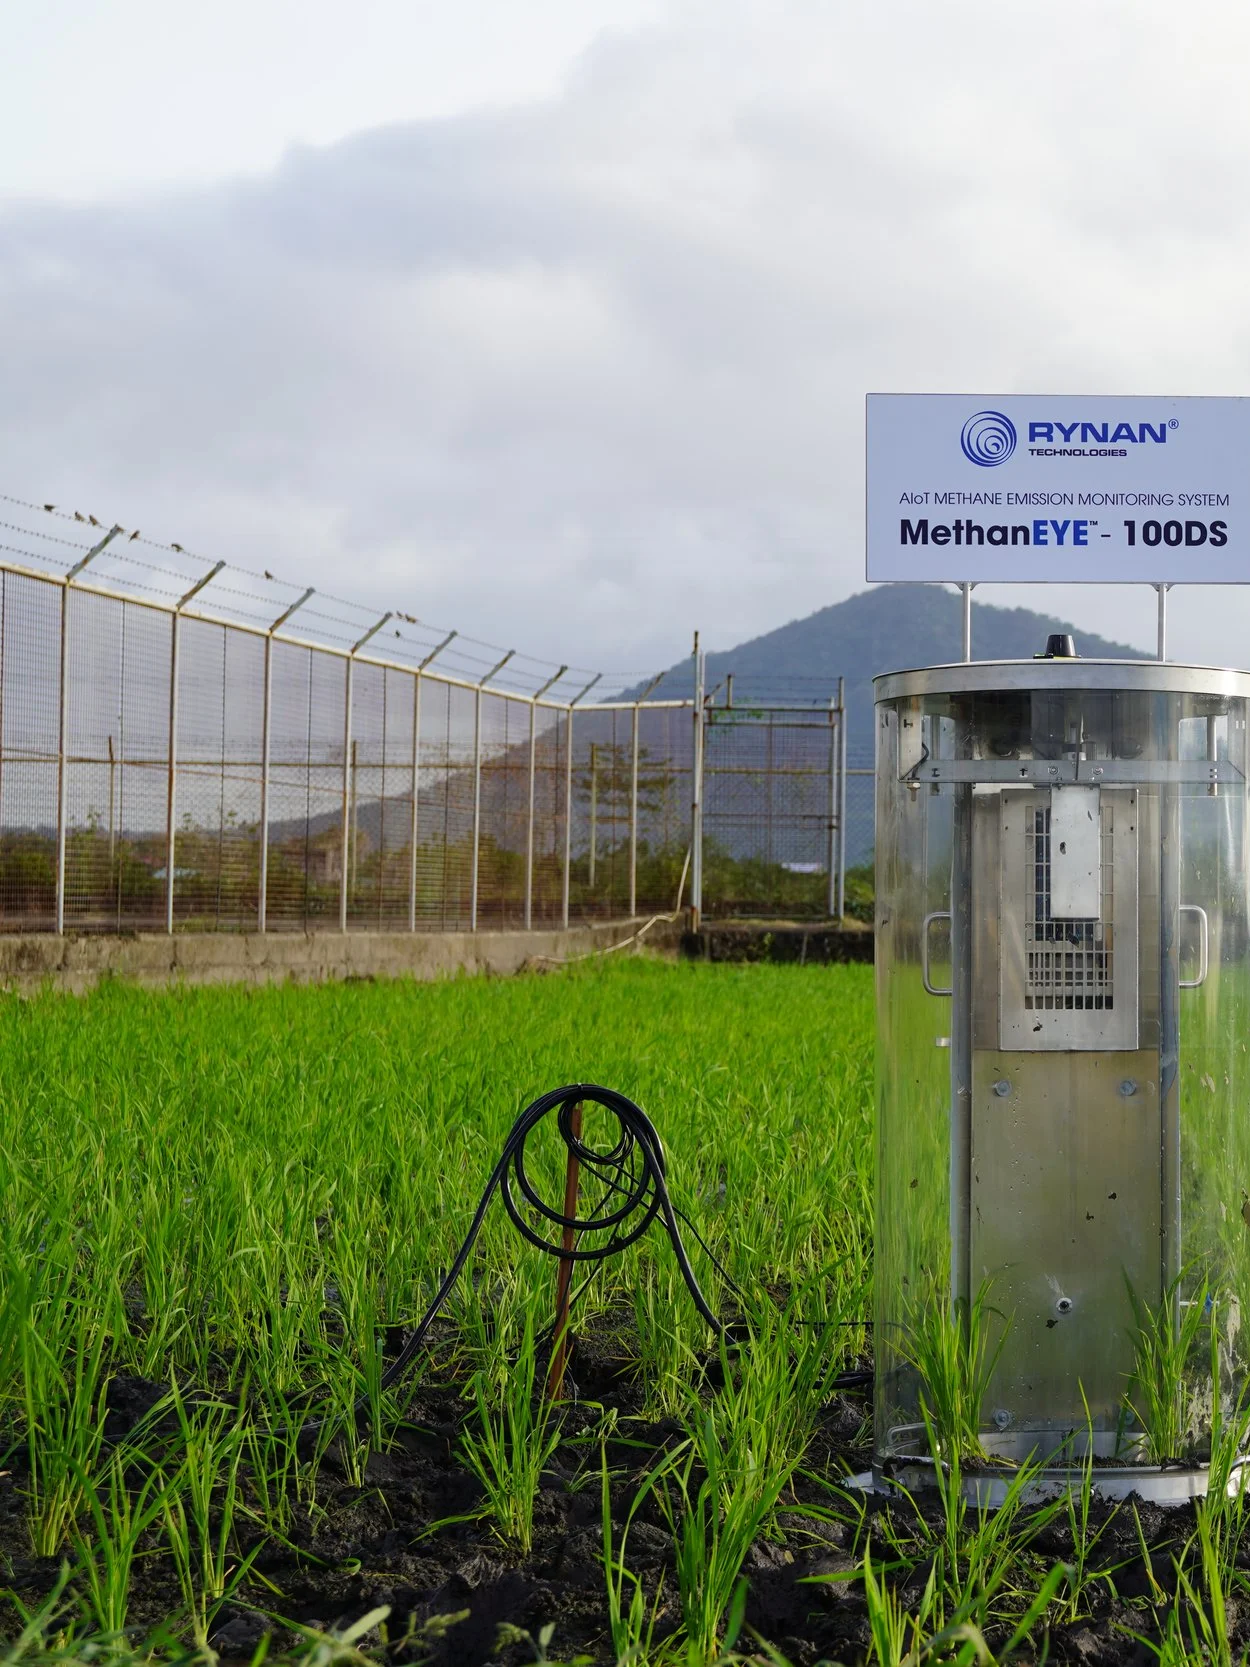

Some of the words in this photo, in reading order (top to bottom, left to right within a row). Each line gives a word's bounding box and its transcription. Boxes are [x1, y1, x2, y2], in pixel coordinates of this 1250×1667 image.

[1028, 448, 1128, 457] TECHNOLOGIES
[934, 492, 1003, 506] METHANE
[1006, 493, 1074, 506] EMISSION
[1078, 493, 1175, 507] MONITORING
[1178, 494, 1230, 507] SYSTEM
[1123, 519, 1228, 547] 100DS
